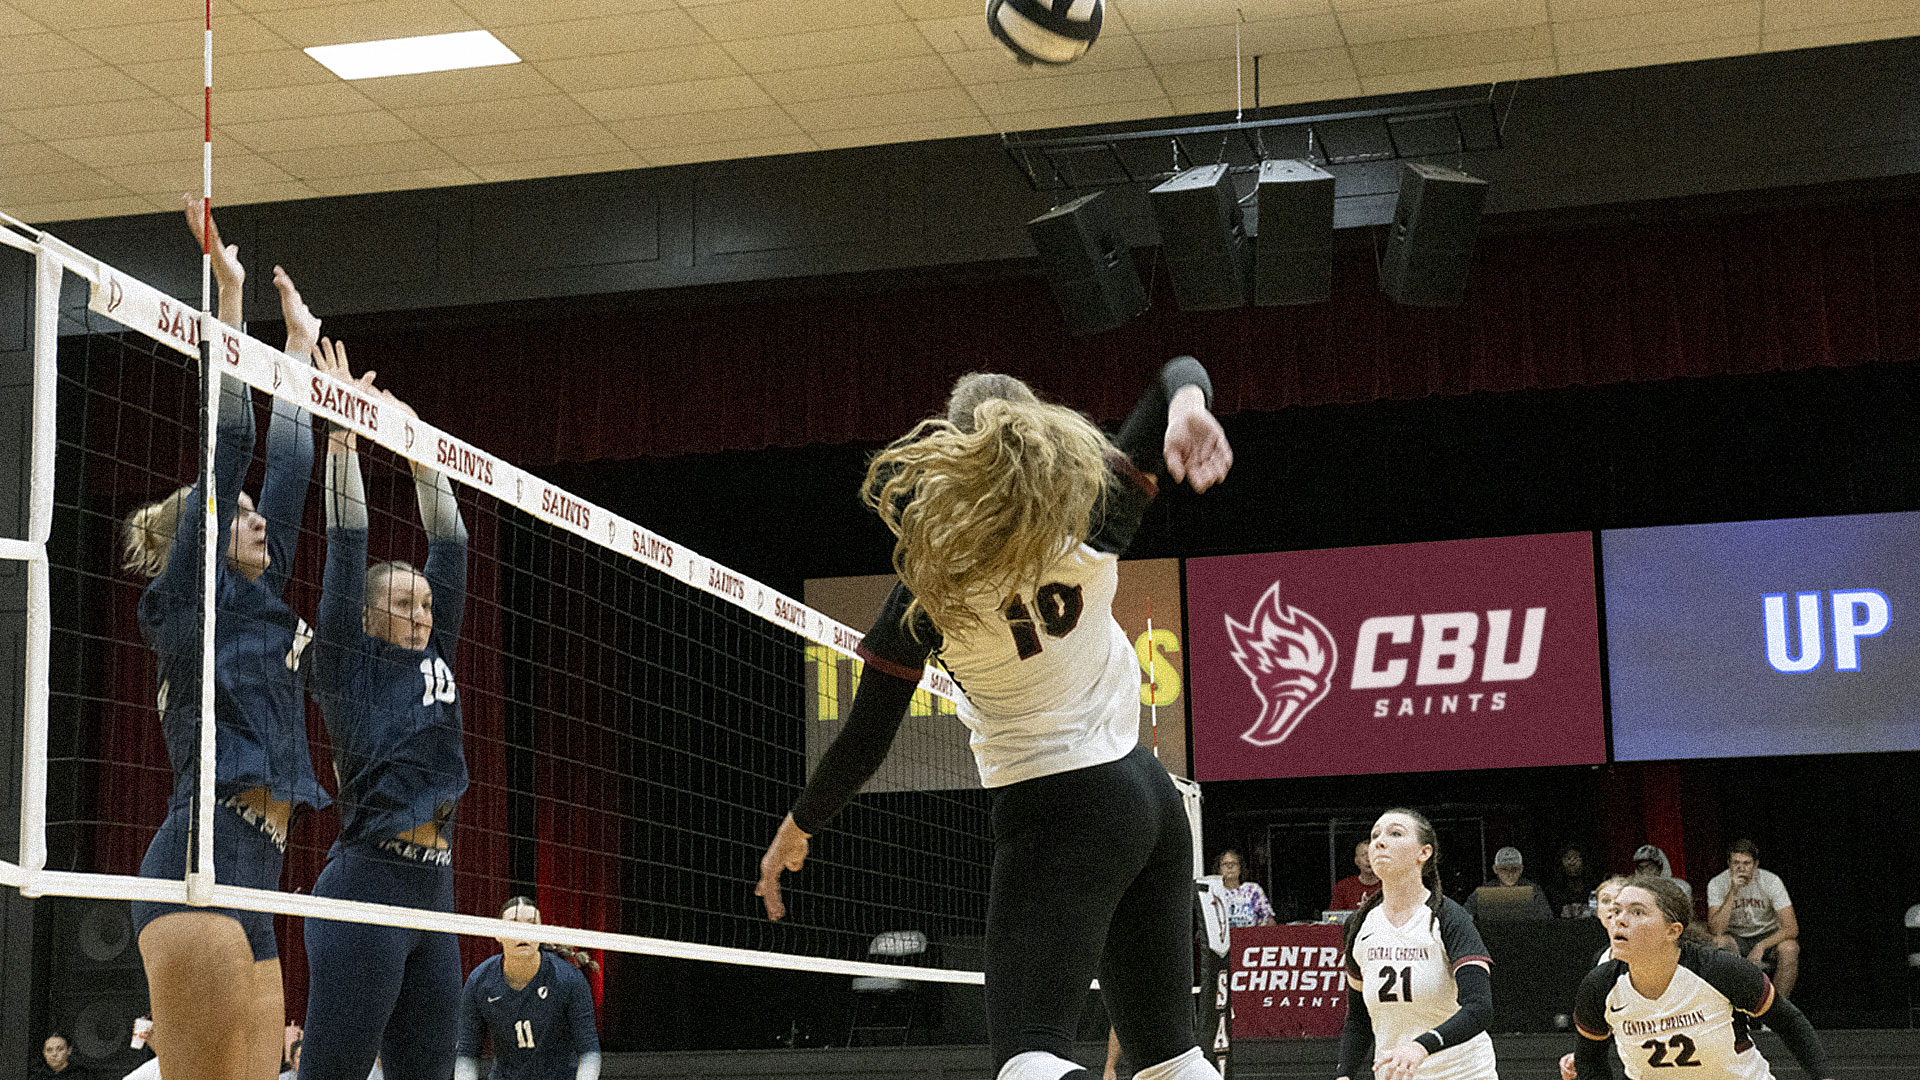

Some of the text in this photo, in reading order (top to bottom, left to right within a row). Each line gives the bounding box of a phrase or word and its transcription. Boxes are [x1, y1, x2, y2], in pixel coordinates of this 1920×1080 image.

[158, 301, 240, 366] SAIS
[310, 376, 380, 432] SAINTS
[436, 437, 494, 486] SAINTS
[541, 487, 591, 530] SAINTS
[631, 529, 675, 569] SAINTS
[708, 566, 745, 600] SAINTS
[774, 597, 806, 629] SAINTS
[1762, 588, 1892, 674] UP
[1350, 607, 1547, 690] CBU
[419, 657, 456, 707] 10
[1373, 692, 1507, 718] SAINTS
[1242, 946, 1346, 968] CENTR
[1367, 947, 1429, 961] CENTRAL CHRISTIAN
[1378, 966, 1412, 1003] 21
[514, 1020, 535, 1048] 11
[1622, 1010, 1705, 1036] CENTRAL CHRISTIAN
[1641, 1033, 1702, 1068] 22
